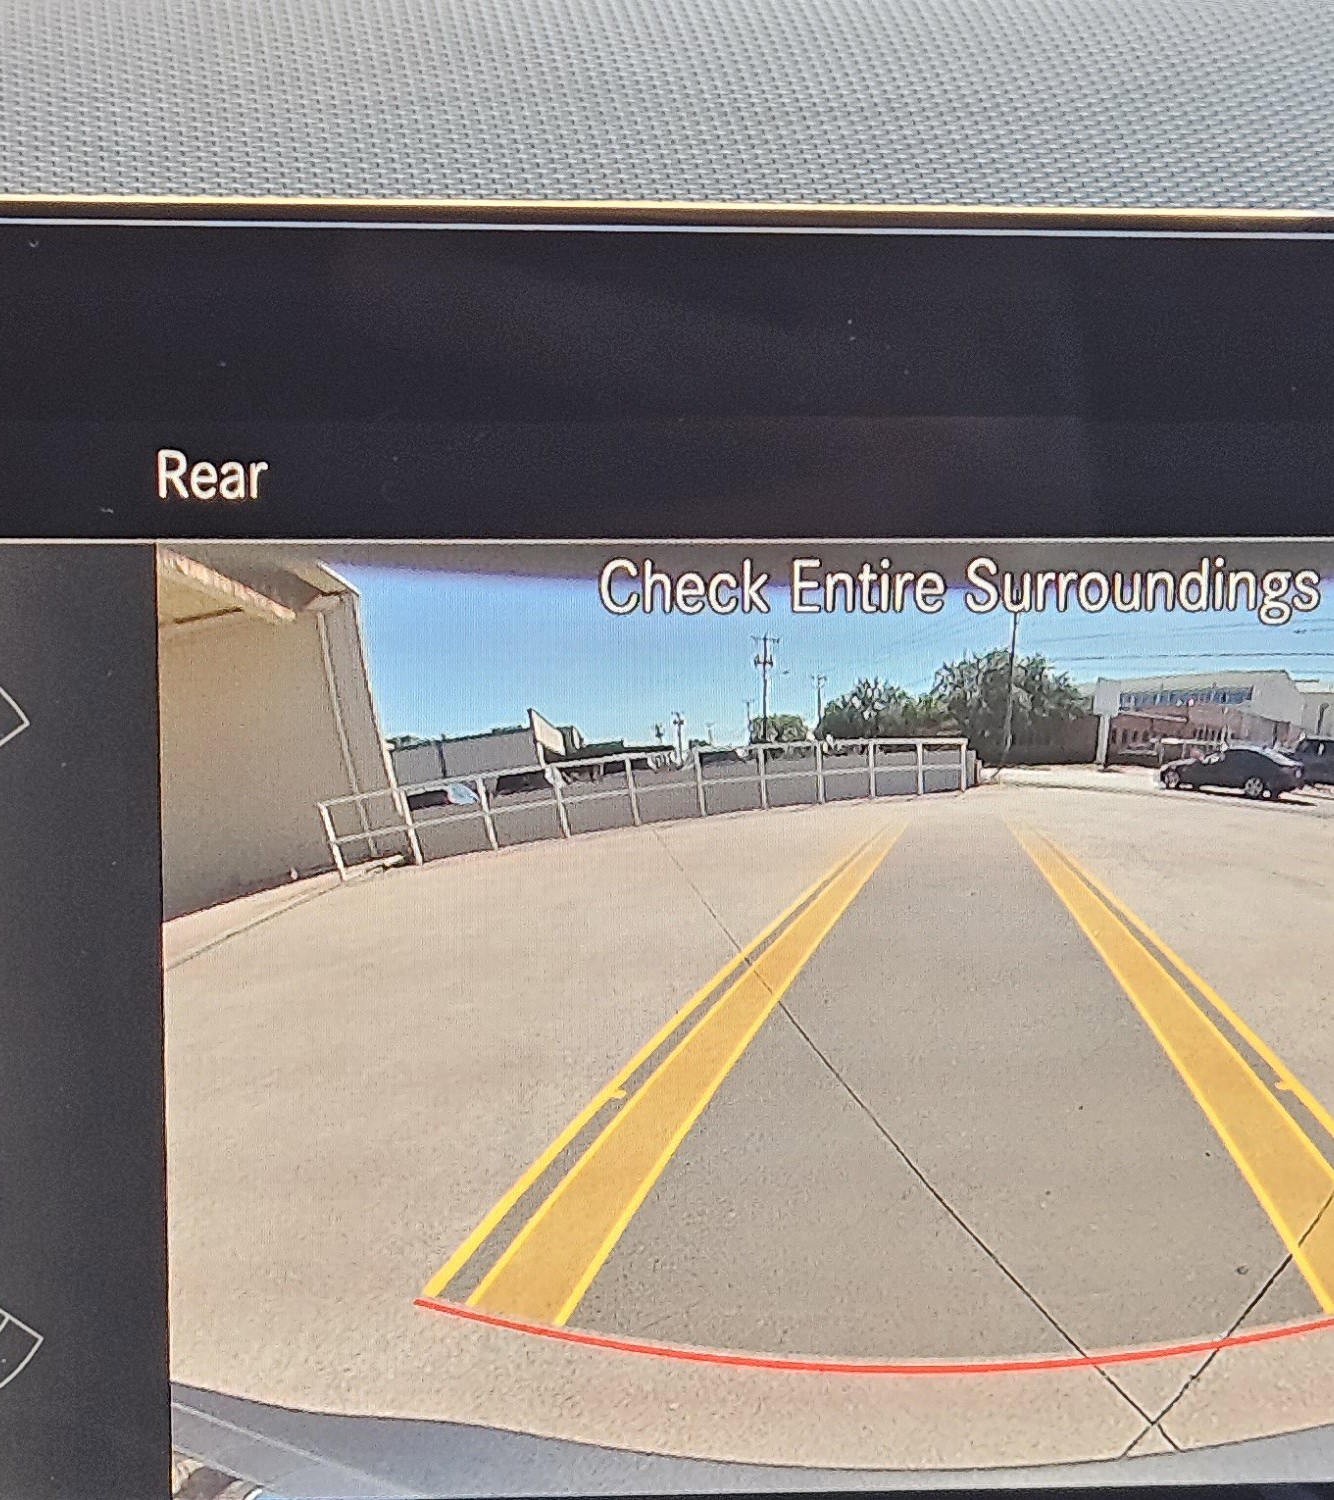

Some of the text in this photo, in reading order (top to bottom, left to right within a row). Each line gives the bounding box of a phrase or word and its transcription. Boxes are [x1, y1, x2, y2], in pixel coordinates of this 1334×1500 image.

[157, 449, 269, 500] Rear
[598, 557, 1322, 625] Check Entire Surroundings
